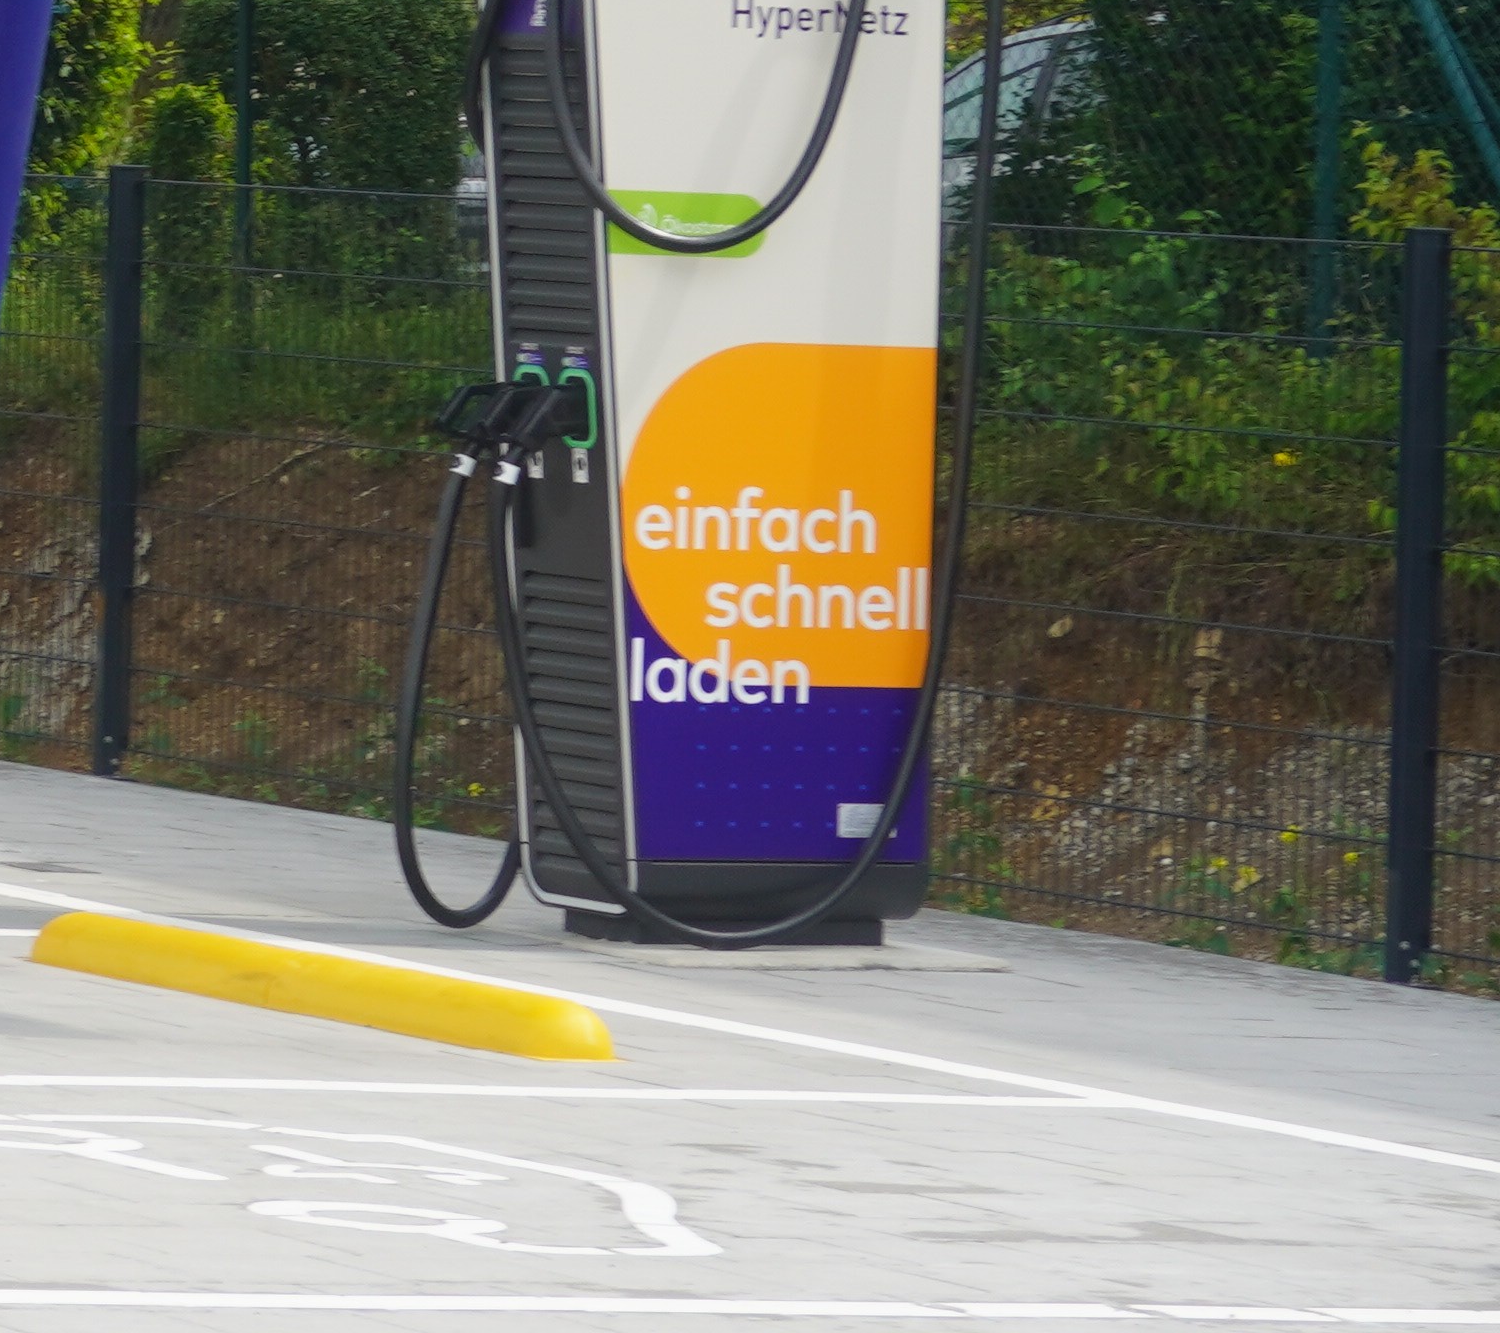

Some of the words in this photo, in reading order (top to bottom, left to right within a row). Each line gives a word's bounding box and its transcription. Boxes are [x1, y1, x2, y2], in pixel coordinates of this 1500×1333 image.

[635, 486, 877, 553] einfach
[703, 564, 928, 631] schnell
[630, 637, 810, 704] laden
